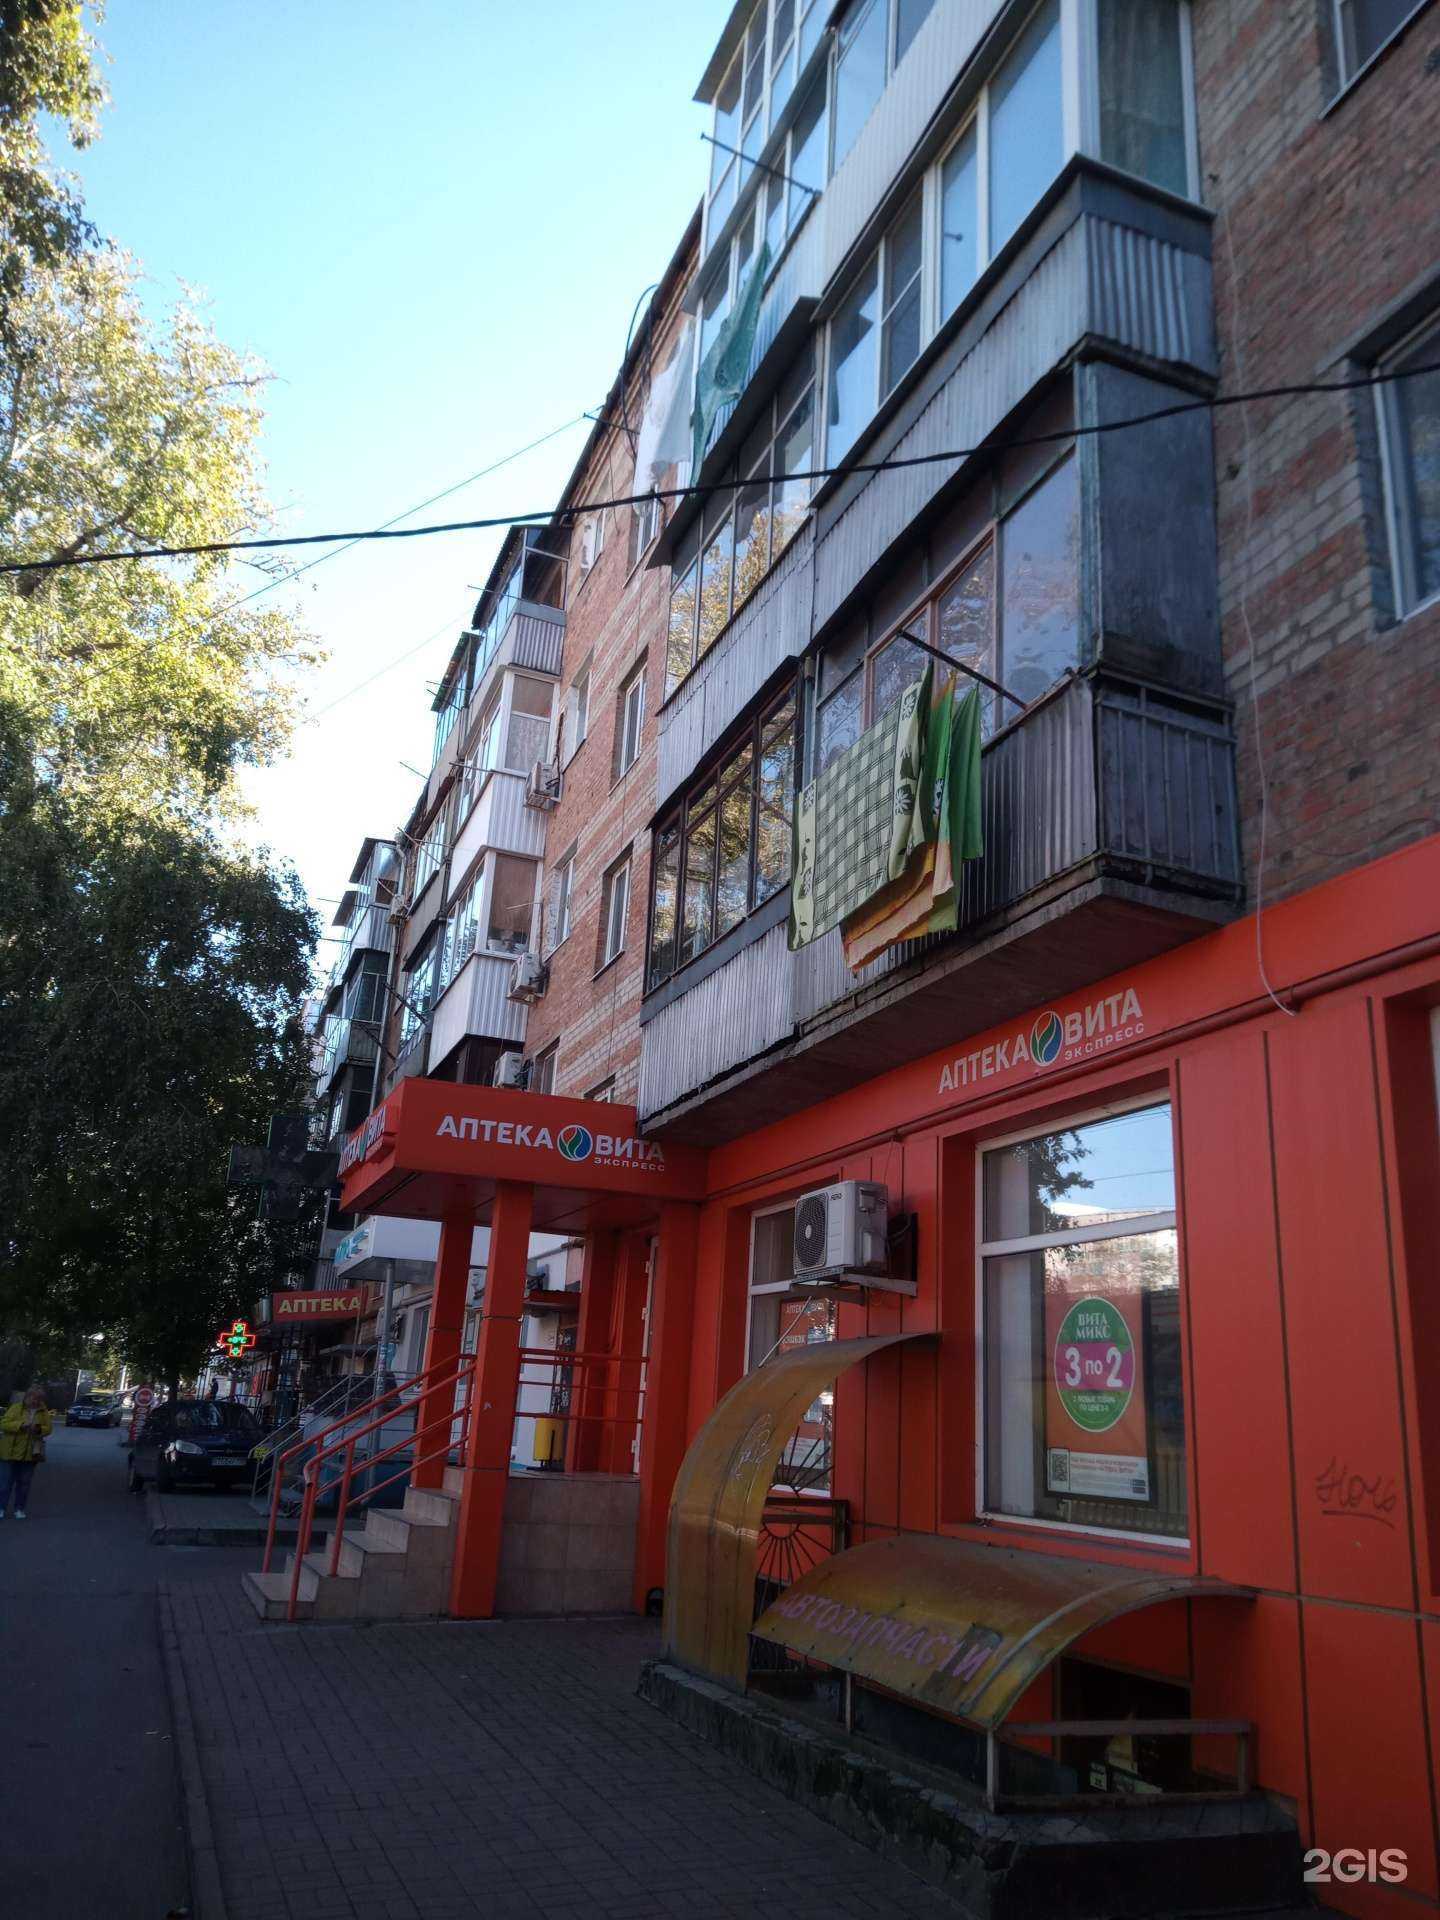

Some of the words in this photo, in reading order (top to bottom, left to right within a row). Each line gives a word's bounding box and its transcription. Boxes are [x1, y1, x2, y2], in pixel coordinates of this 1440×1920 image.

[938, 1034, 1029, 1094] АПТЕКА
[1064, 988, 1143, 1045] ВИТА
[1064, 1023, 1145, 1060] ЭКСПРЕСС
[436, 1115, 553, 1150] АПТЕКА
[595, 1135, 665, 1162] ВИТА
[593, 1157, 665, 1172] ЭКСПРЕСС
[278, 1296, 361, 1313] АПТЕКА
[1076, 1325, 1111, 1339] МИКС
[1078, 1312, 1107, 1326] ВИТА
[1065, 1346, 1081, 1387] 3
[1106, 1346, 1123, 1387] 2
